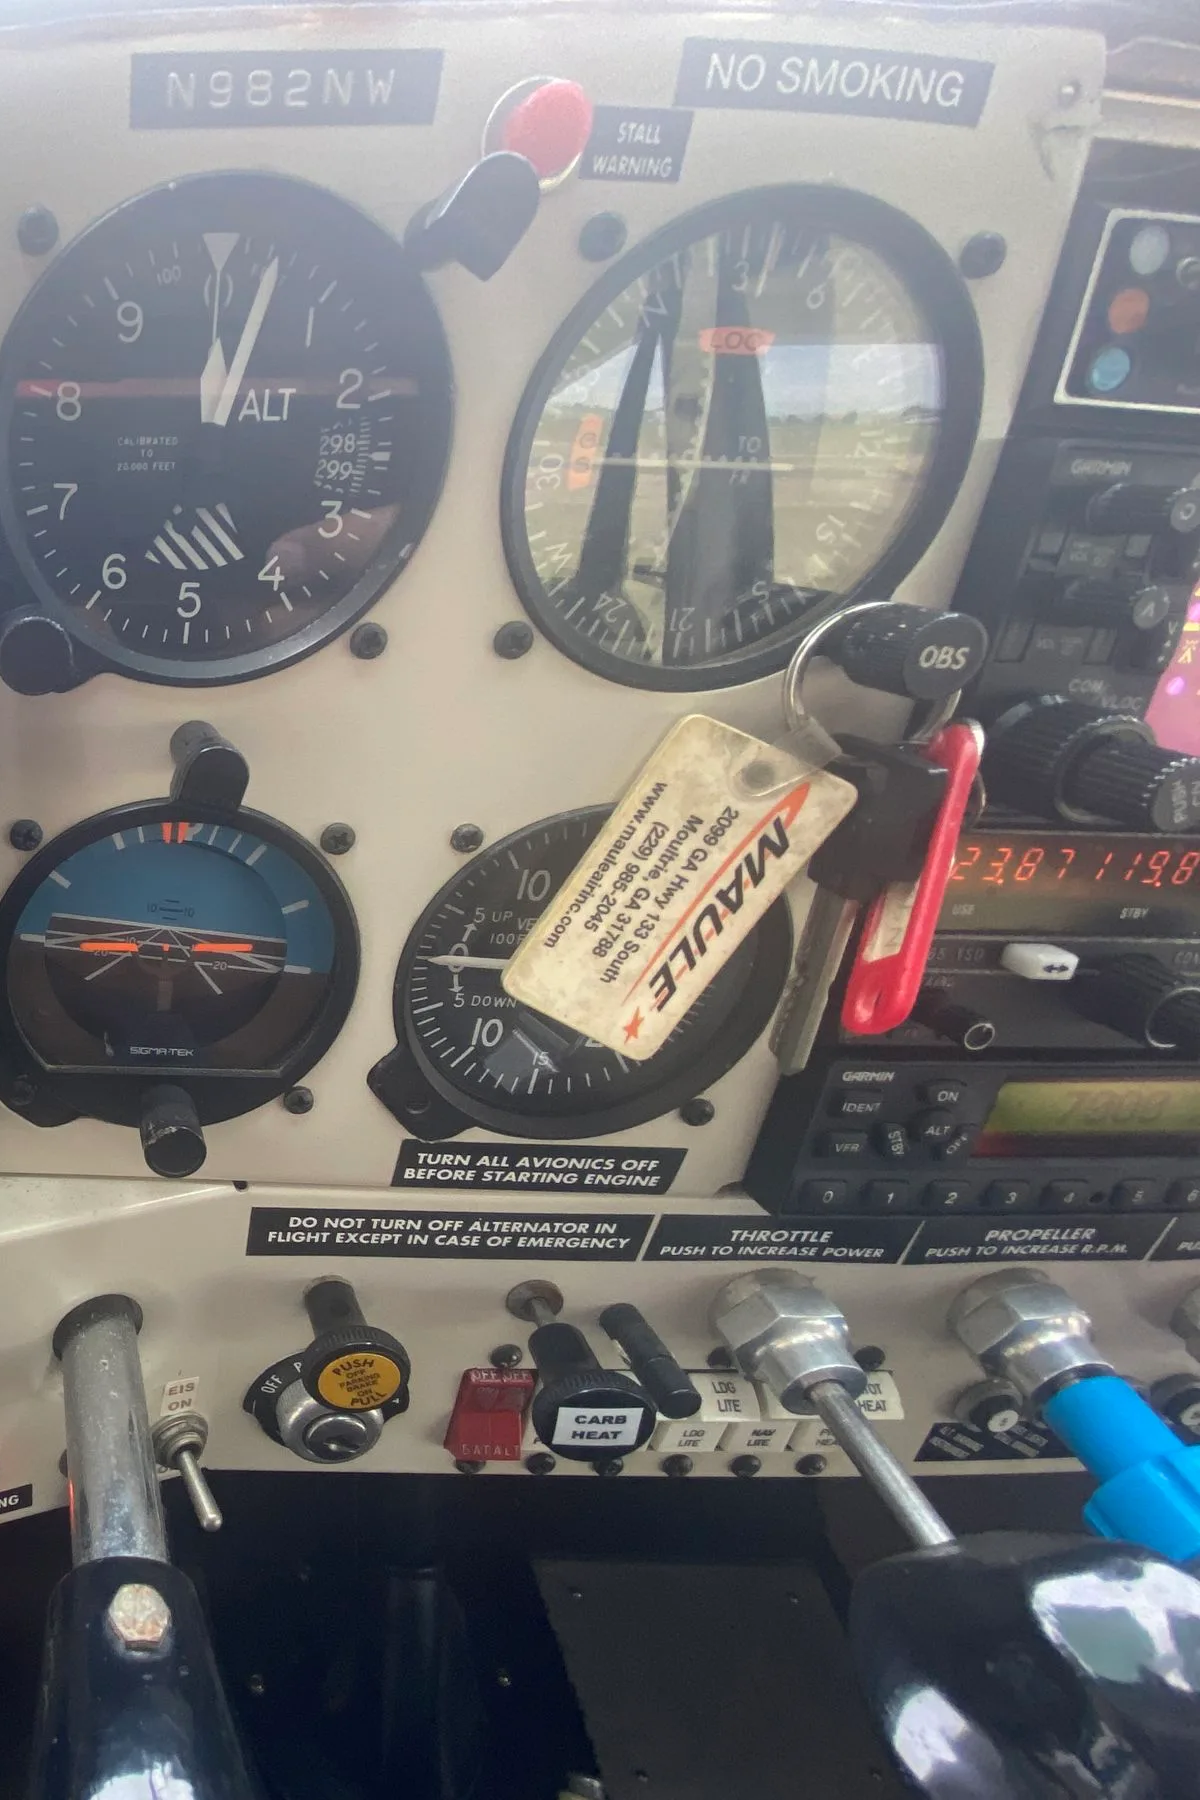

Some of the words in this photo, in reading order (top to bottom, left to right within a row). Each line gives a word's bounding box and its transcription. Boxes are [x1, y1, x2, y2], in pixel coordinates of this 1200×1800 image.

[166, 66, 397, 110] N982NW
[706, 53, 765, 92] NO
[774, 58, 964, 107] SMOKING
[616, 120, 662, 144] STALL
[592, 153, 673, 178] WARNING
[115, 300, 144, 343] 9
[336, 368, 364, 409] 2
[55, 382, 82, 422] 8
[238, 388, 296, 422] ALT
[53, 483, 78, 521] 7
[317, 500, 342, 538] 3
[102, 553, 127, 589] 6
[258, 556, 286, 591] 4
[177, 583, 201, 618] 5
[919, 645, 967, 671] OBS
[703, 805, 739, 846] 2099
[635, 821, 670, 861] (229)
[642, 814, 703, 880] Moultrie,
[543, 781, 667, 948] www.mauleairinc.com
[681, 848, 708, 873] GA
[517, 870, 551, 902] 10
[584, 862, 640, 933] 985-2045
[625, 886, 650, 911] GA
[655, 873, 689, 910] Hwy
[634, 913, 661, 940] 133
[648, 815, 790, 1012] MAULE
[591, 913, 631, 958] 31788
[600, 941, 640, 984] South
[471, 1018, 504, 1046] 10
[842, 1071, 896, 1082] GARMIN
[842, 1102, 881, 1113] IDENT
[937, 1090, 960, 1102] ON
[924, 1125, 951, 1136] ALT
[417, 1152, 471, 1166] TURN
[476, 1155, 510, 1168] ALL
[516, 1156, 615, 1171] AVIONICS
[621, 1159, 659, 1172] OFF
[403, 1168, 476, 1181] BEFORE
[481, 1171, 579, 1185] STARTING
[583, 1174, 661, 1187] ENGINE
[288, 1216, 317, 1228] DO
[323, 1217, 366, 1229] NOT
[371, 1217, 423, 1231] TURN
[427, 1219, 465, 1232] OFF
[469, 1219, 591, 1234] ALTERNATOR
[594, 1222, 618, 1234] IN
[730, 1229, 833, 1243] THROTTLE
[984, 1228, 1096, 1242] PROPELLER
[267, 1231, 331, 1243] FLIGHT
[335, 1232, 401, 1245] EXCEPT
[406, 1233, 430, 1246] IN
[435, 1234, 481, 1247] CASE
[486, 1235, 513, 1247] OF
[516, 1236, 632, 1250] EMERGENCY
[659, 1245, 706, 1256] PUSH
[712, 1246, 734, 1256] TO
[737, 1246, 819, 1257] INCREASE
[822, 1247, 885, 1258] POWER
[925, 1247, 971, 1258] PUSH
[976, 1245, 998, 1256] TO
[1001, 1243, 1076, 1255] INCREASE
[168, 1382, 195, 1396] EIS
[712, 1382, 736, 1394] LDG
[167, 1398, 192, 1411] ON
[718, 1400, 741, 1412] LITE
[575, 1415, 627, 1424] CARB
[571, 1431, 622, 1440] HEAT
